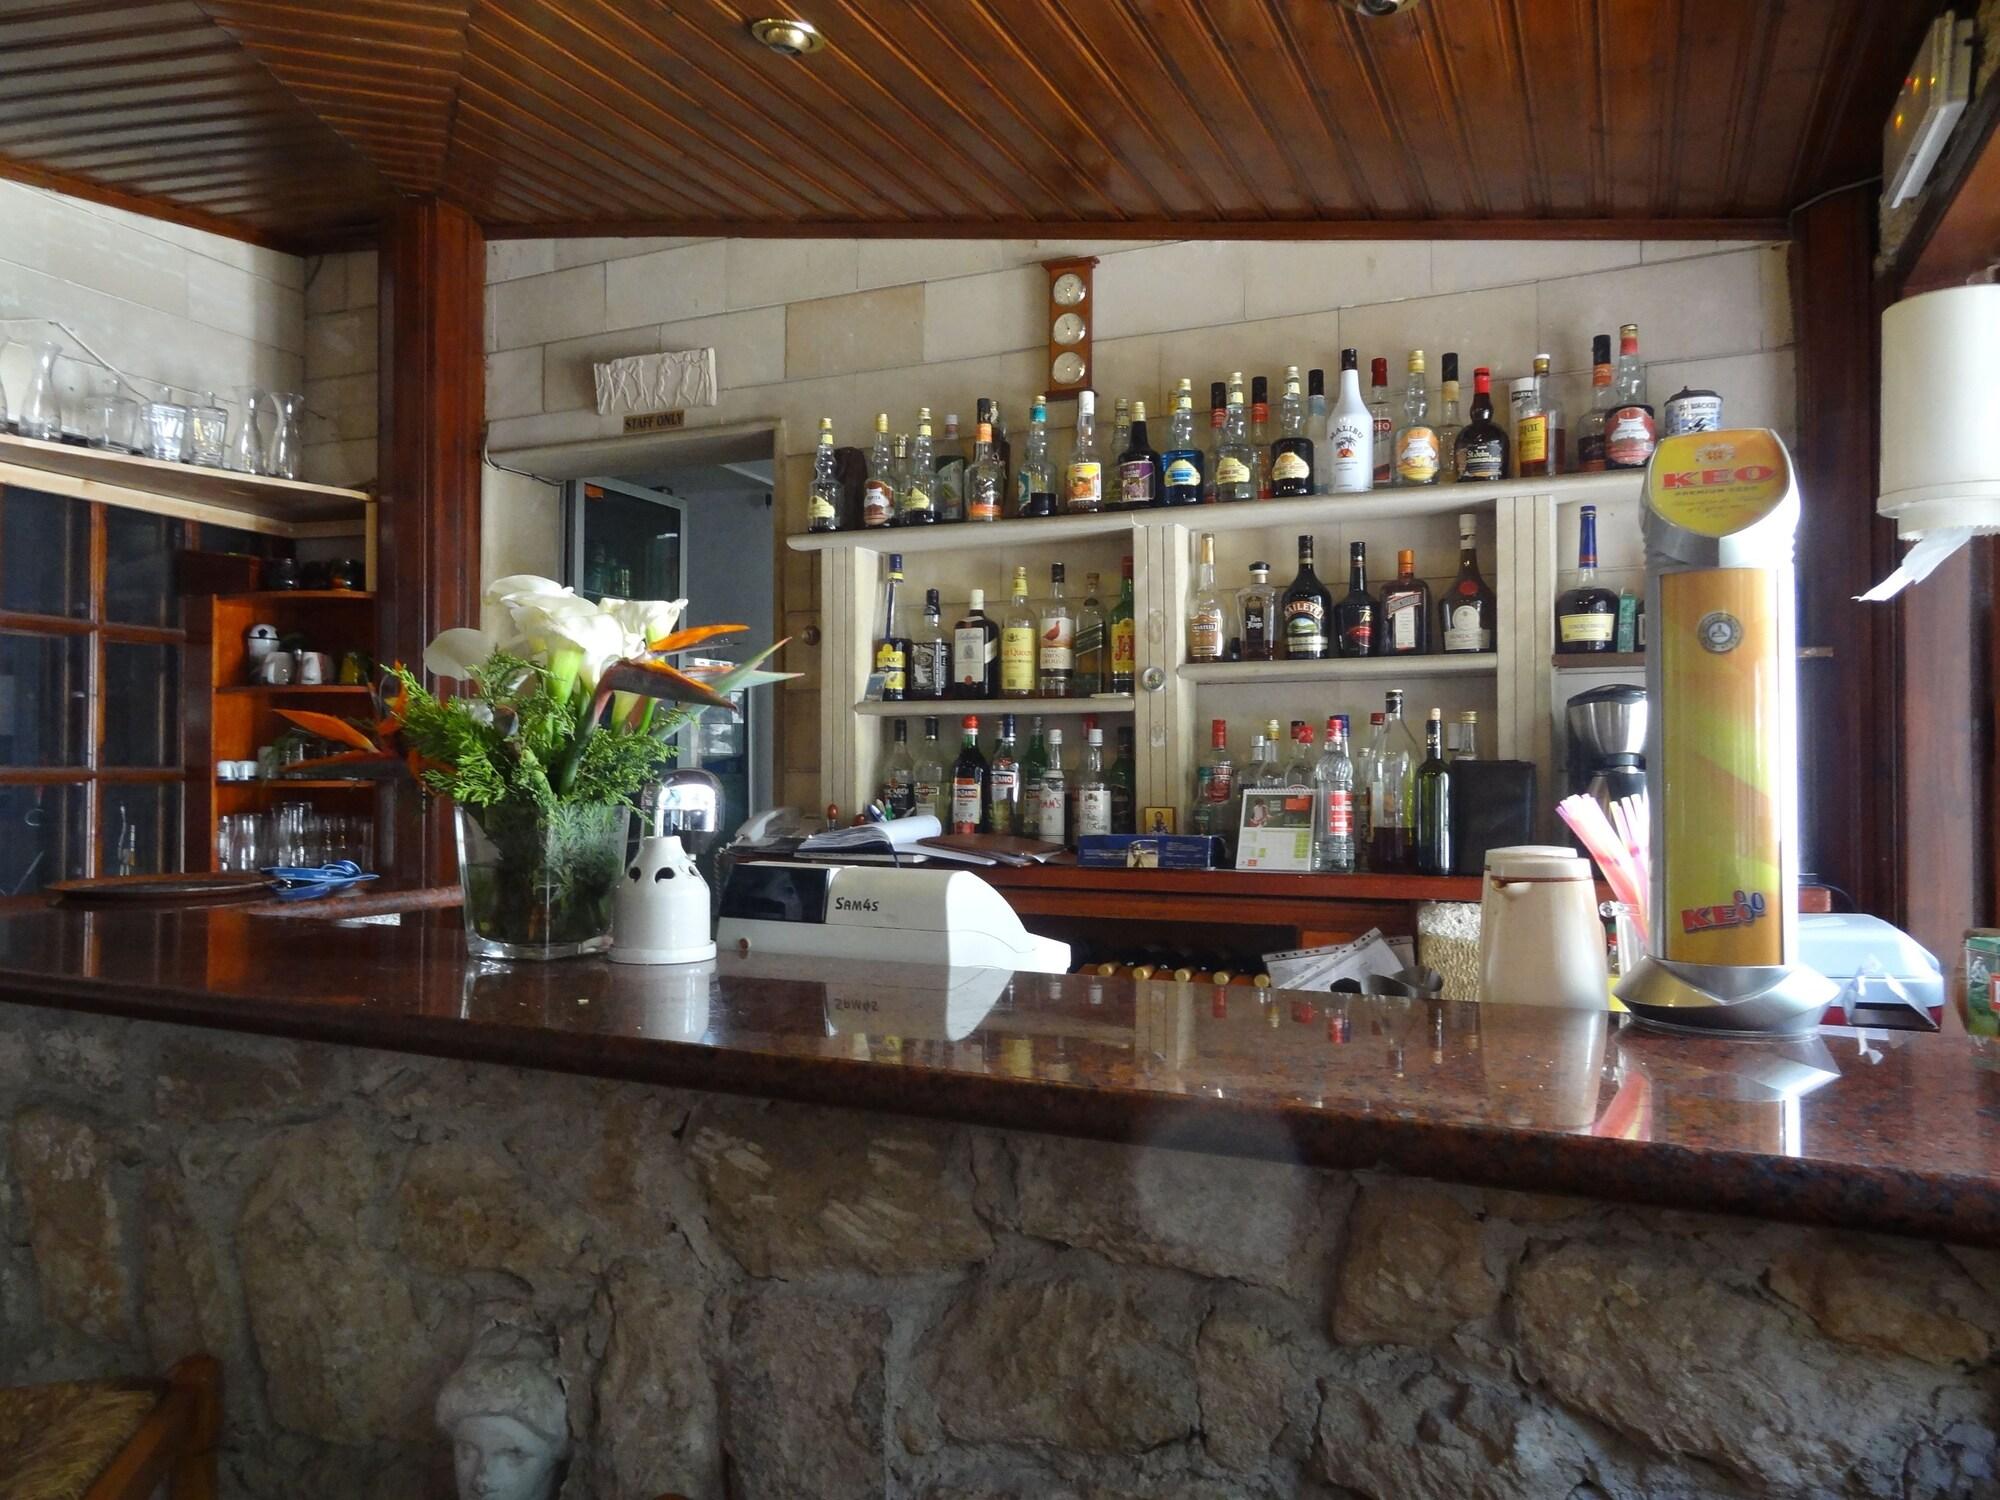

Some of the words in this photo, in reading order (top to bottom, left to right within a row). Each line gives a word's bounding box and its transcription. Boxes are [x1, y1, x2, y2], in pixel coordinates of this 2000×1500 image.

[624, 415, 655, 430] STAFF
[656, 411, 684, 427] ONLY
[1330, 425, 1364, 440] MALIBU
[1662, 464, 1776, 488] KEO
